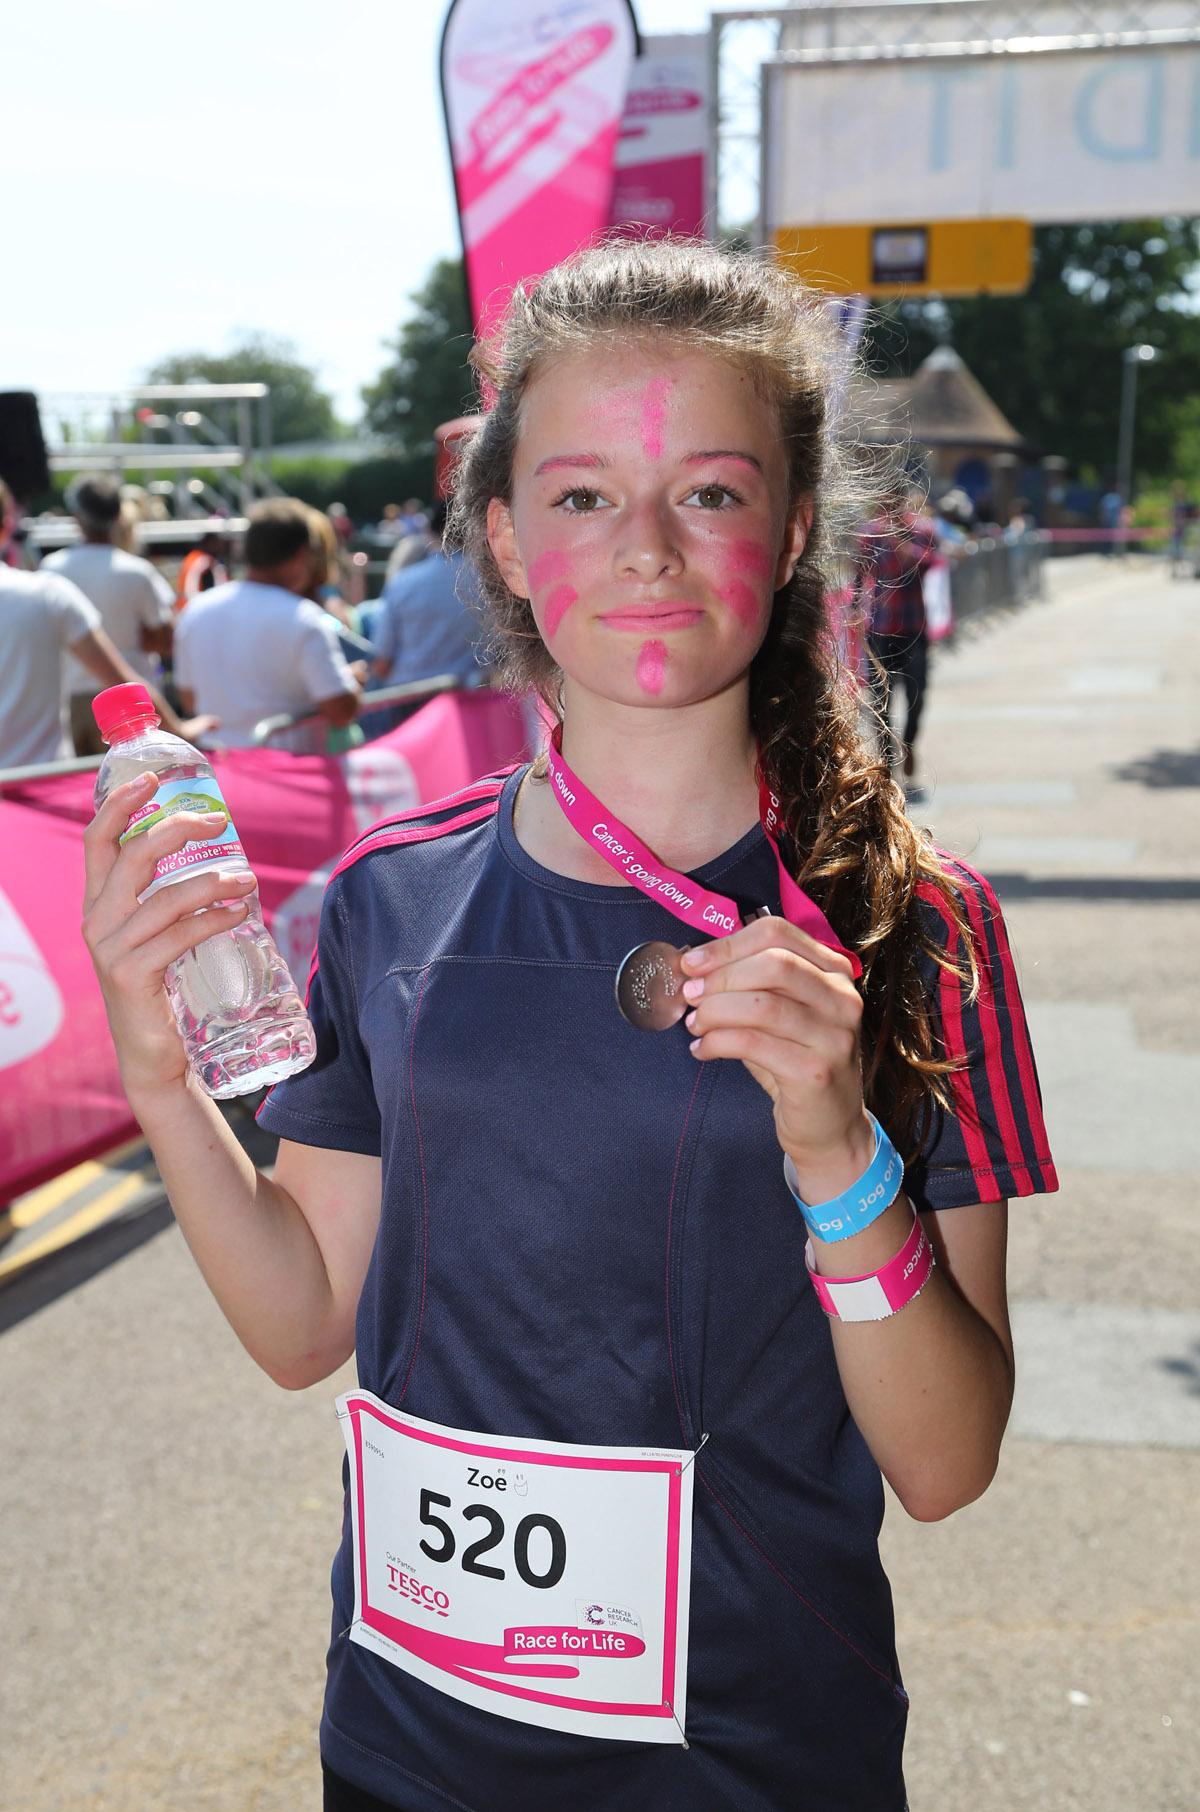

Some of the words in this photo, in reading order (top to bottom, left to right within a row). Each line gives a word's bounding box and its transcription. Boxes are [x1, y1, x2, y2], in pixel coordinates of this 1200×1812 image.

[555, 772, 576, 806] down
[157, 861, 176, 875] We
[178, 848, 222, 866] Donate!
[592, 823, 634, 864] Cancer's
[626, 863, 659, 888] going
[659, 882, 693, 910] down
[857, 1184, 885, 1212] Jog
[884, 1160, 895, 1182] on
[818, 1217, 843, 1232] og
[419, 1488, 567, 1590] 520
[386, 1551, 396, 1562] Our
[386, 1564, 449, 1609] TESCO
[607, 1607, 631, 1618] CANCER
[607, 1613, 638, 1627] RESEARCH
[514, 1632, 556, 1649] Race
[561, 1632, 588, 1649] for
[592, 1633, 626, 1651] Life
